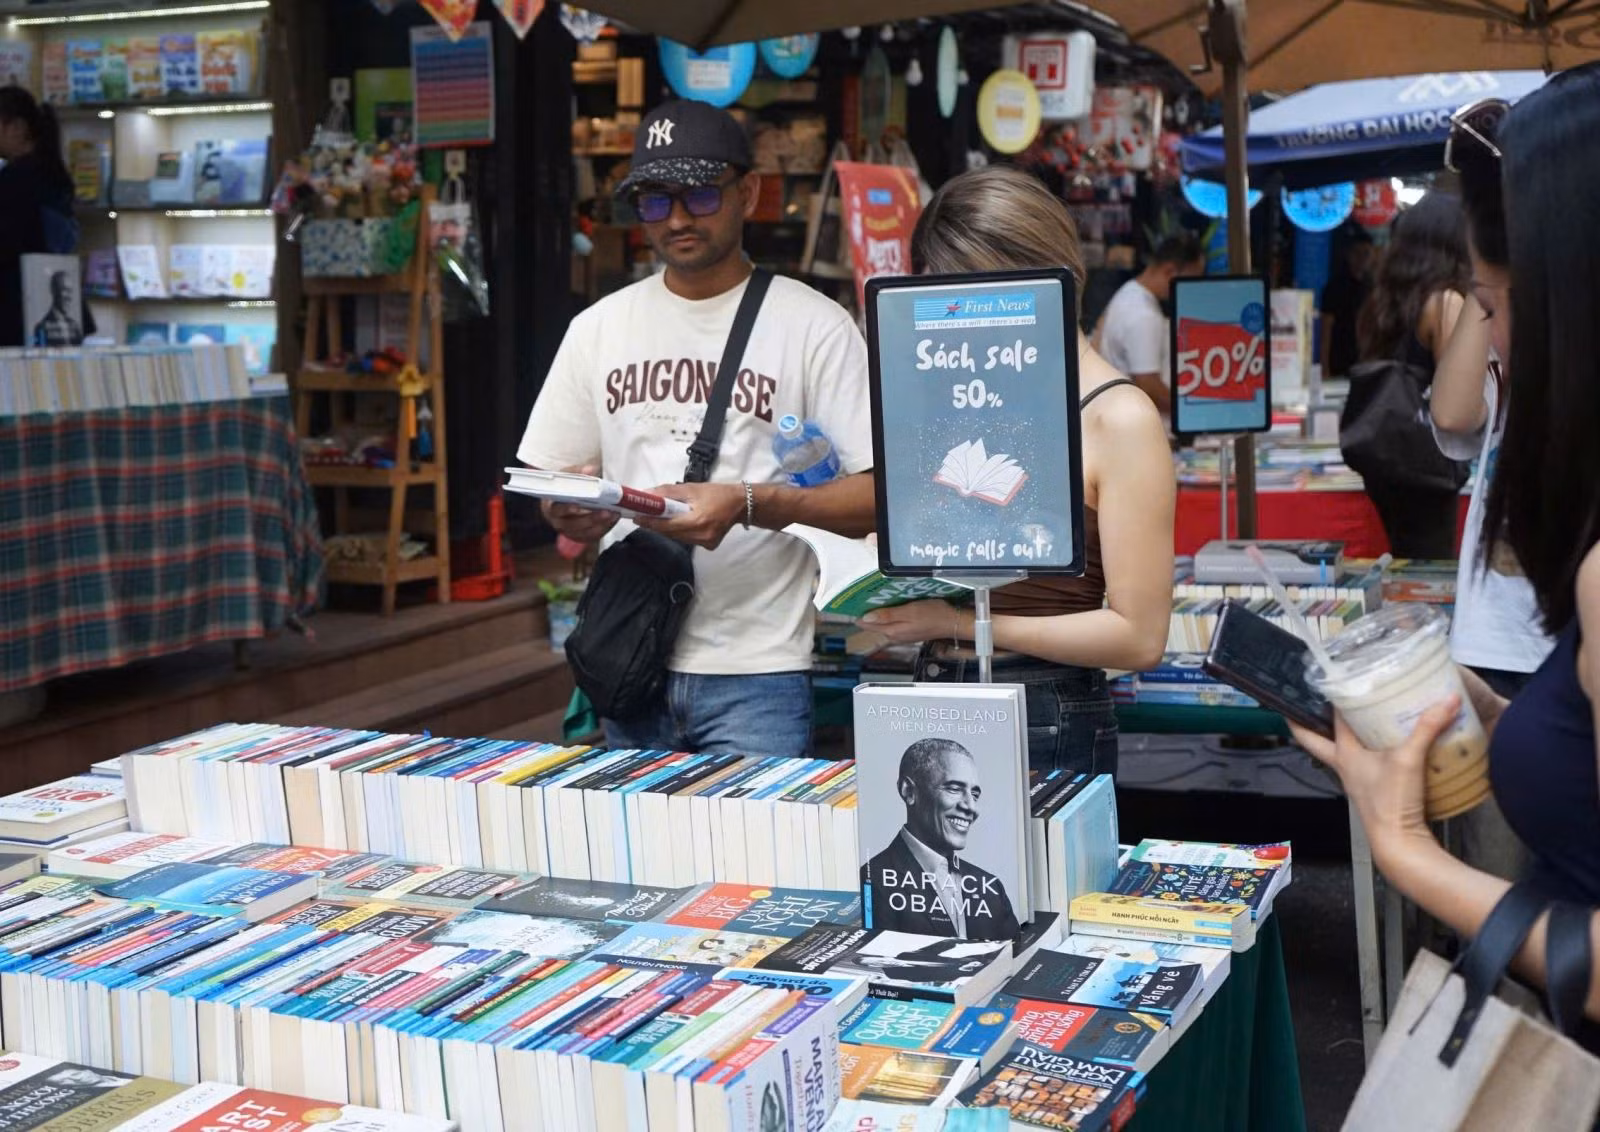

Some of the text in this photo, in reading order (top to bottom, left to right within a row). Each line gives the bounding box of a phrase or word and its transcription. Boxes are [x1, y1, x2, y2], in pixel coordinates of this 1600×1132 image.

[646, 118, 676, 149] NY
[964, 298, 1030, 314] First News
[915, 339, 1038, 373] Sách sale
[1177, 336, 1265, 396] 50%
[606, 358, 777, 424] SAIGONSE
[952, 378, 1003, 409] 50%
[910, 542, 960, 567] magic
[966, 540, 1006, 561] falls
[866, 705, 1009, 722] A PROMISED LAND
[706, 897, 752, 920] BIG
[882, 868, 999, 918] BARACK OBAMA
[747, 974, 806, 984] Edward
[811, 1036, 825, 1100] MARS
[72, 1089, 156, 1132] OBBINS
